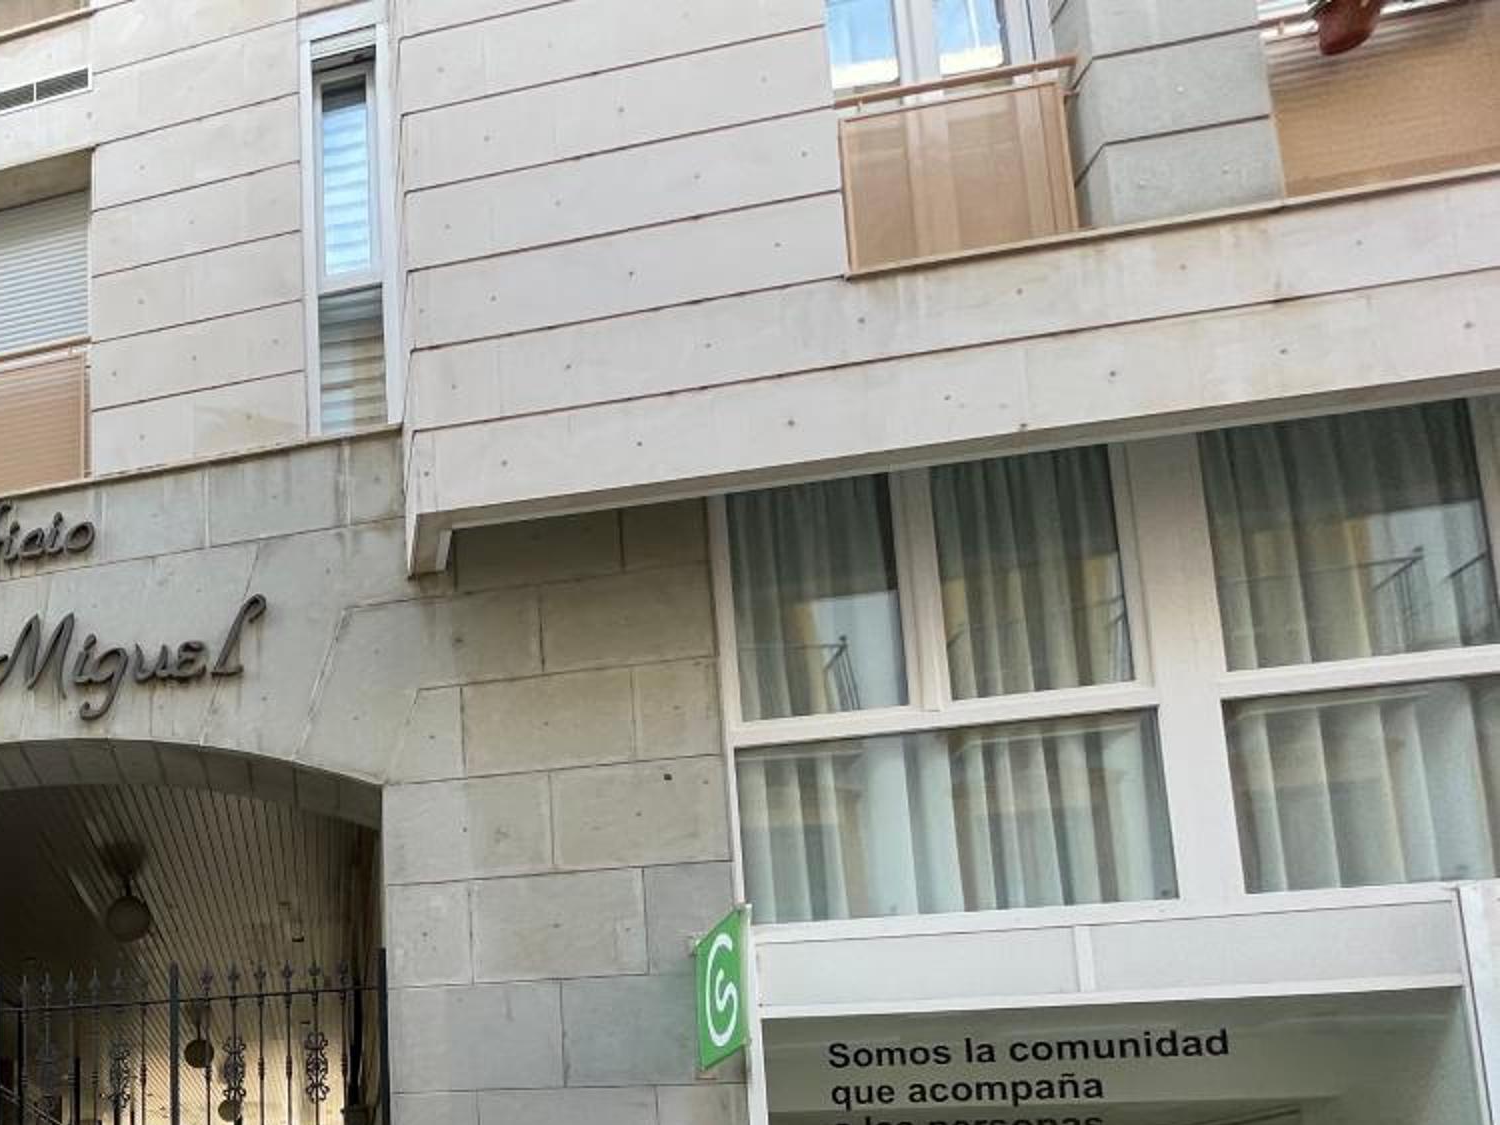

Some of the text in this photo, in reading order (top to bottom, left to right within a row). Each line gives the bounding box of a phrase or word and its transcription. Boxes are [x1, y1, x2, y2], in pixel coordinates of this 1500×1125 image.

[829, 1028, 1229, 1068] Somos la comunidad
[831, 1073, 1103, 1111] que acompaña
